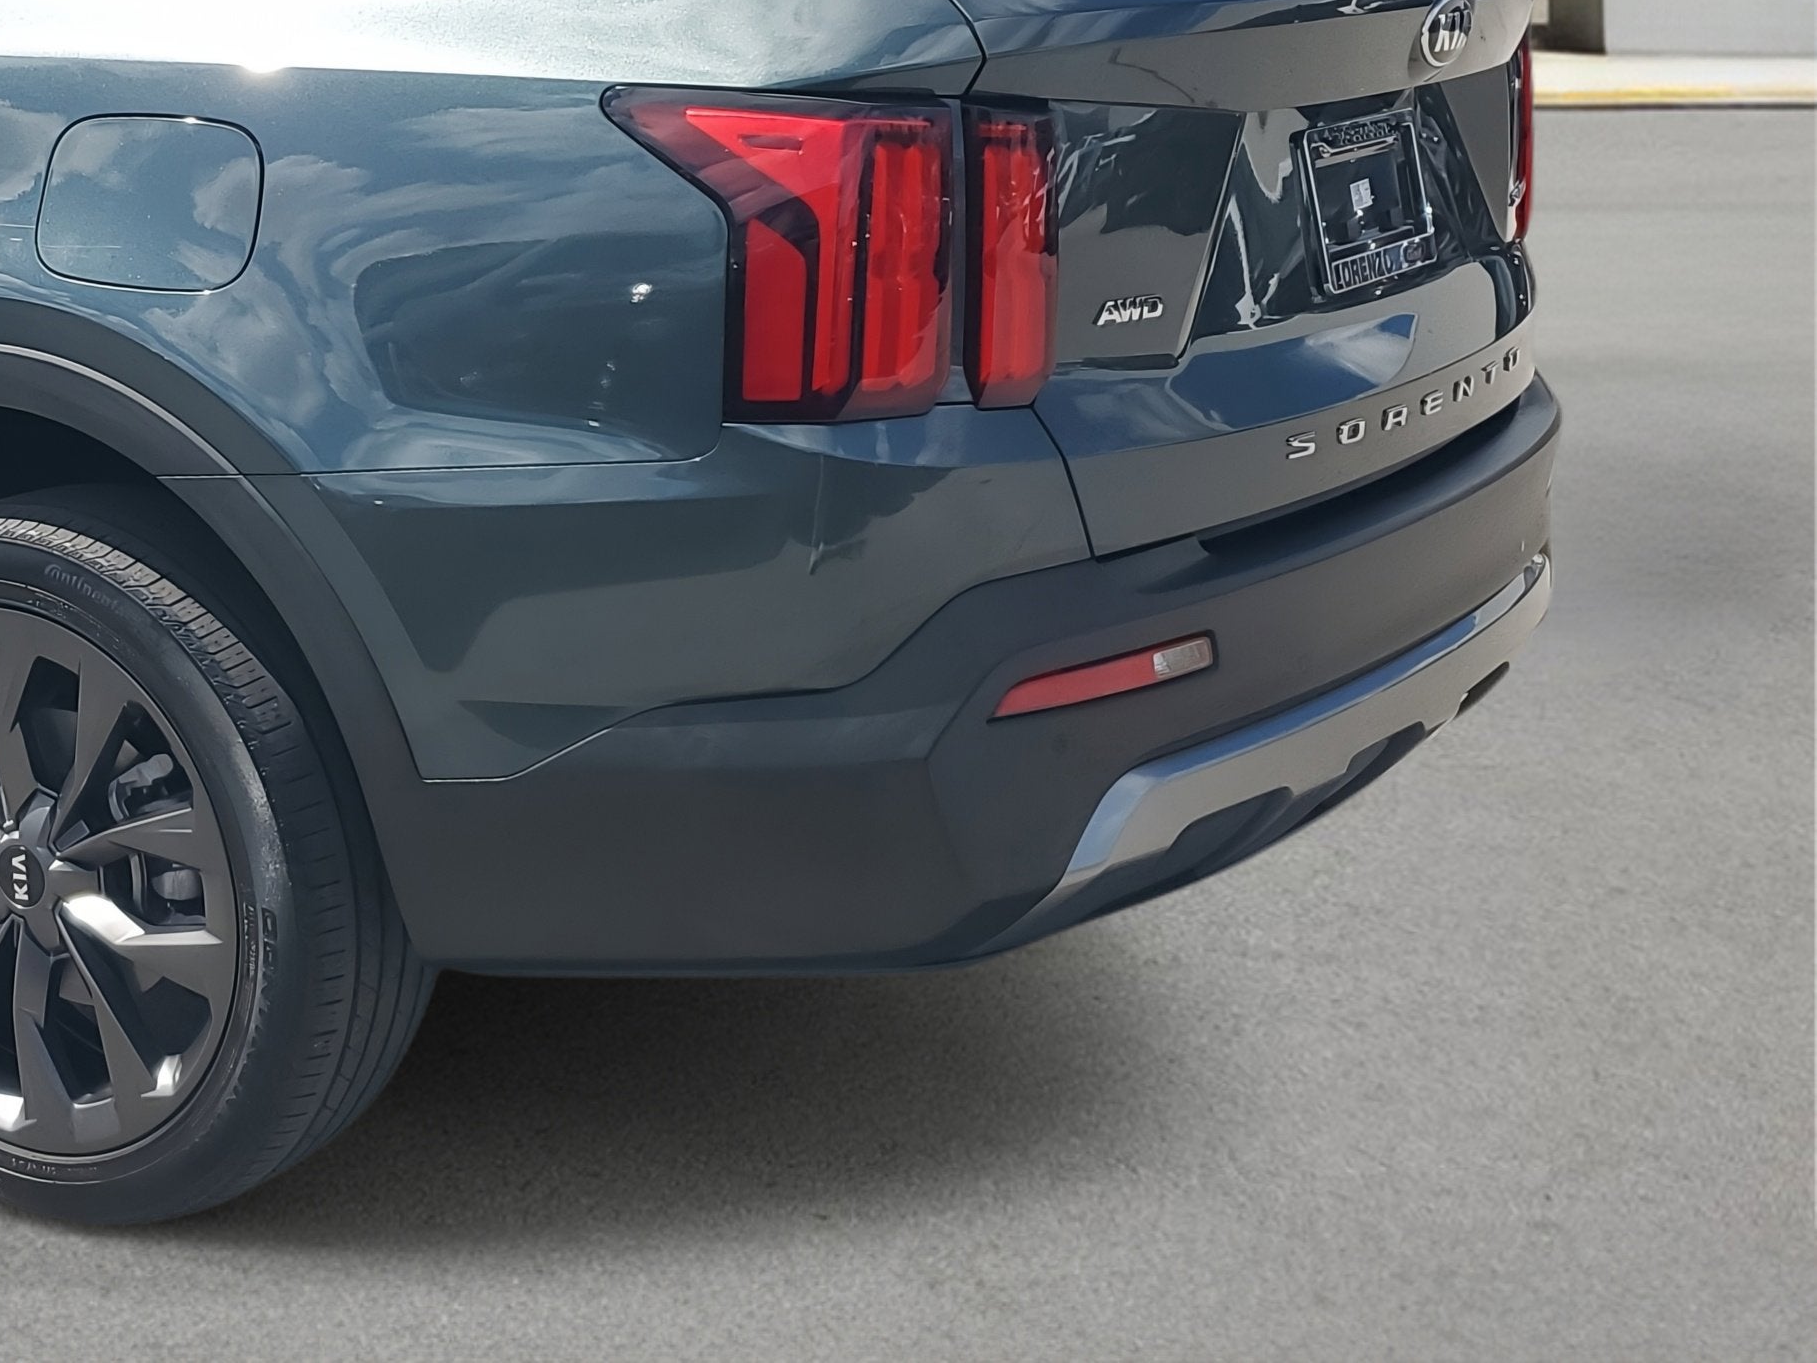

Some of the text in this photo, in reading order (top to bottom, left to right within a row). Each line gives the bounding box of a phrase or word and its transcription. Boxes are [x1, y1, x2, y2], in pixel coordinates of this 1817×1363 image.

[1096, 293, 1164, 327] AWD
[1285, 346, 1522, 460] SORENTO
[43, 563, 127, 619] Continent
[11, 853, 29, 901] KIA
